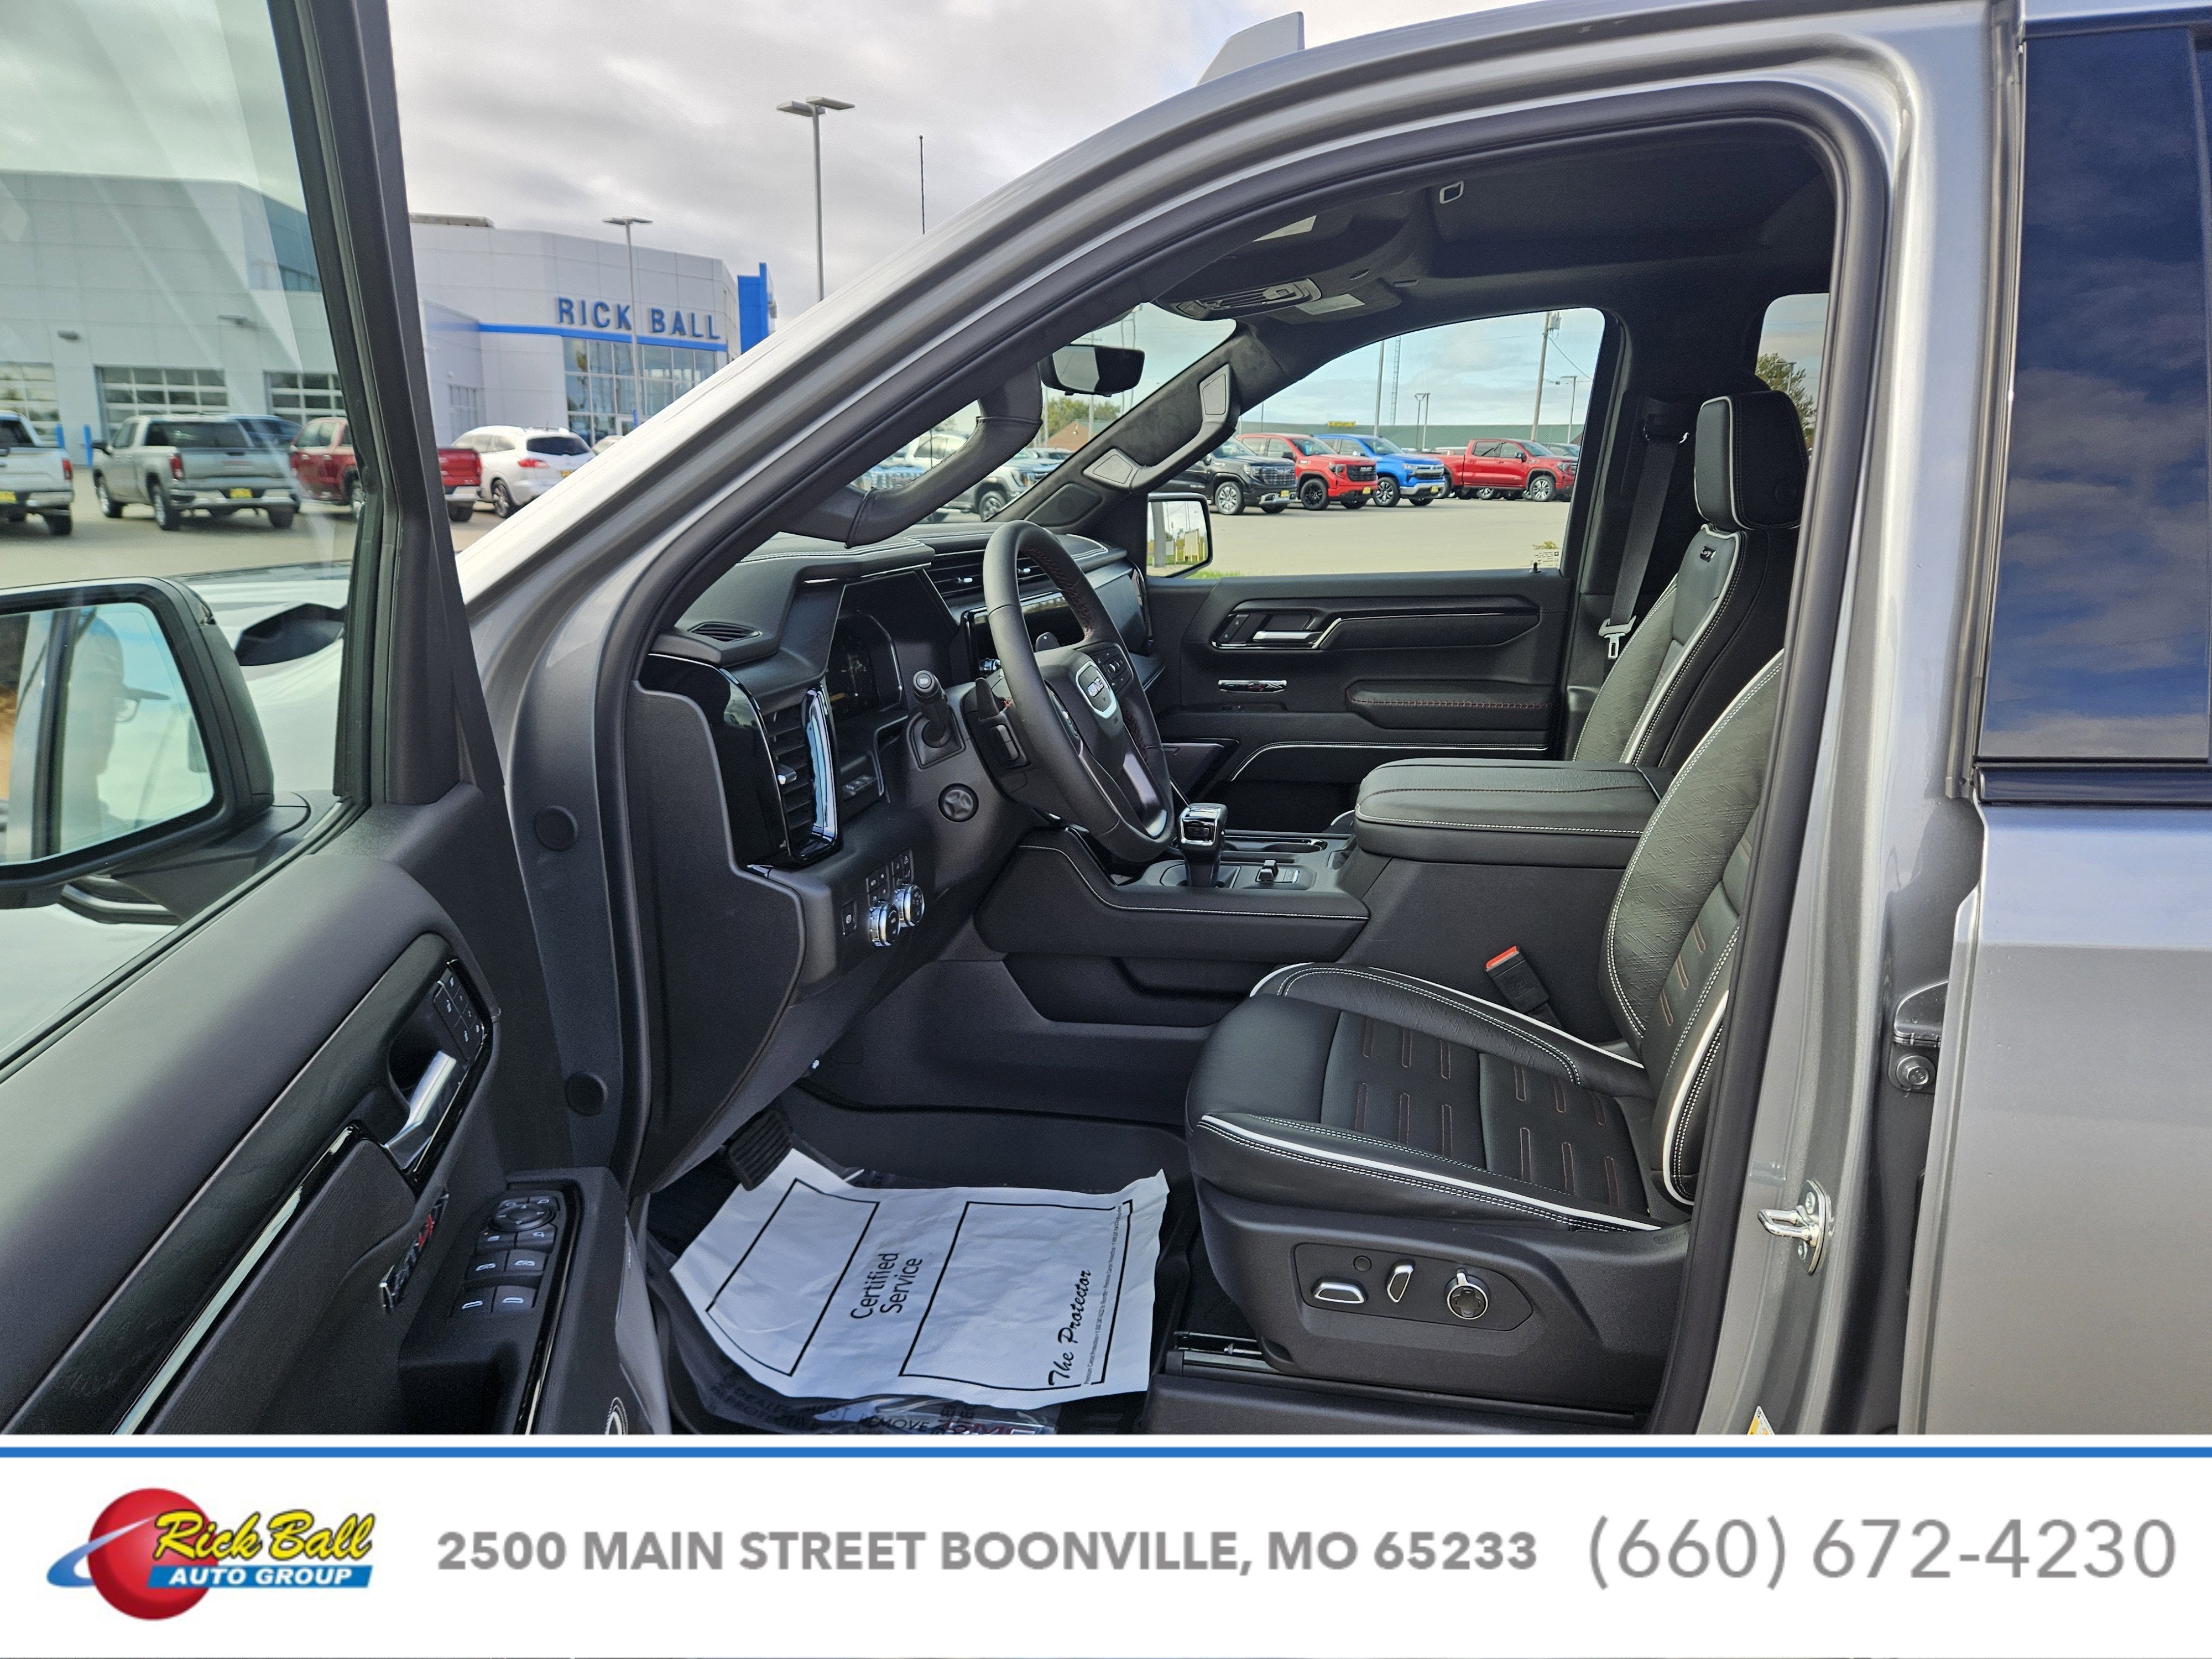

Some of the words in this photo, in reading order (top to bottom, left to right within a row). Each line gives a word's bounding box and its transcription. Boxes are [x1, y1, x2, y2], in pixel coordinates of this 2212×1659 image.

[557, 296, 632, 331] RICK
[650, 307, 721, 340] BALL
[850, 1253, 899, 1319] Certified
[879, 1258, 923, 1313] Service
[1057, 1269, 1092, 1344] Protector
[1048, 1351, 1074, 1386] The
